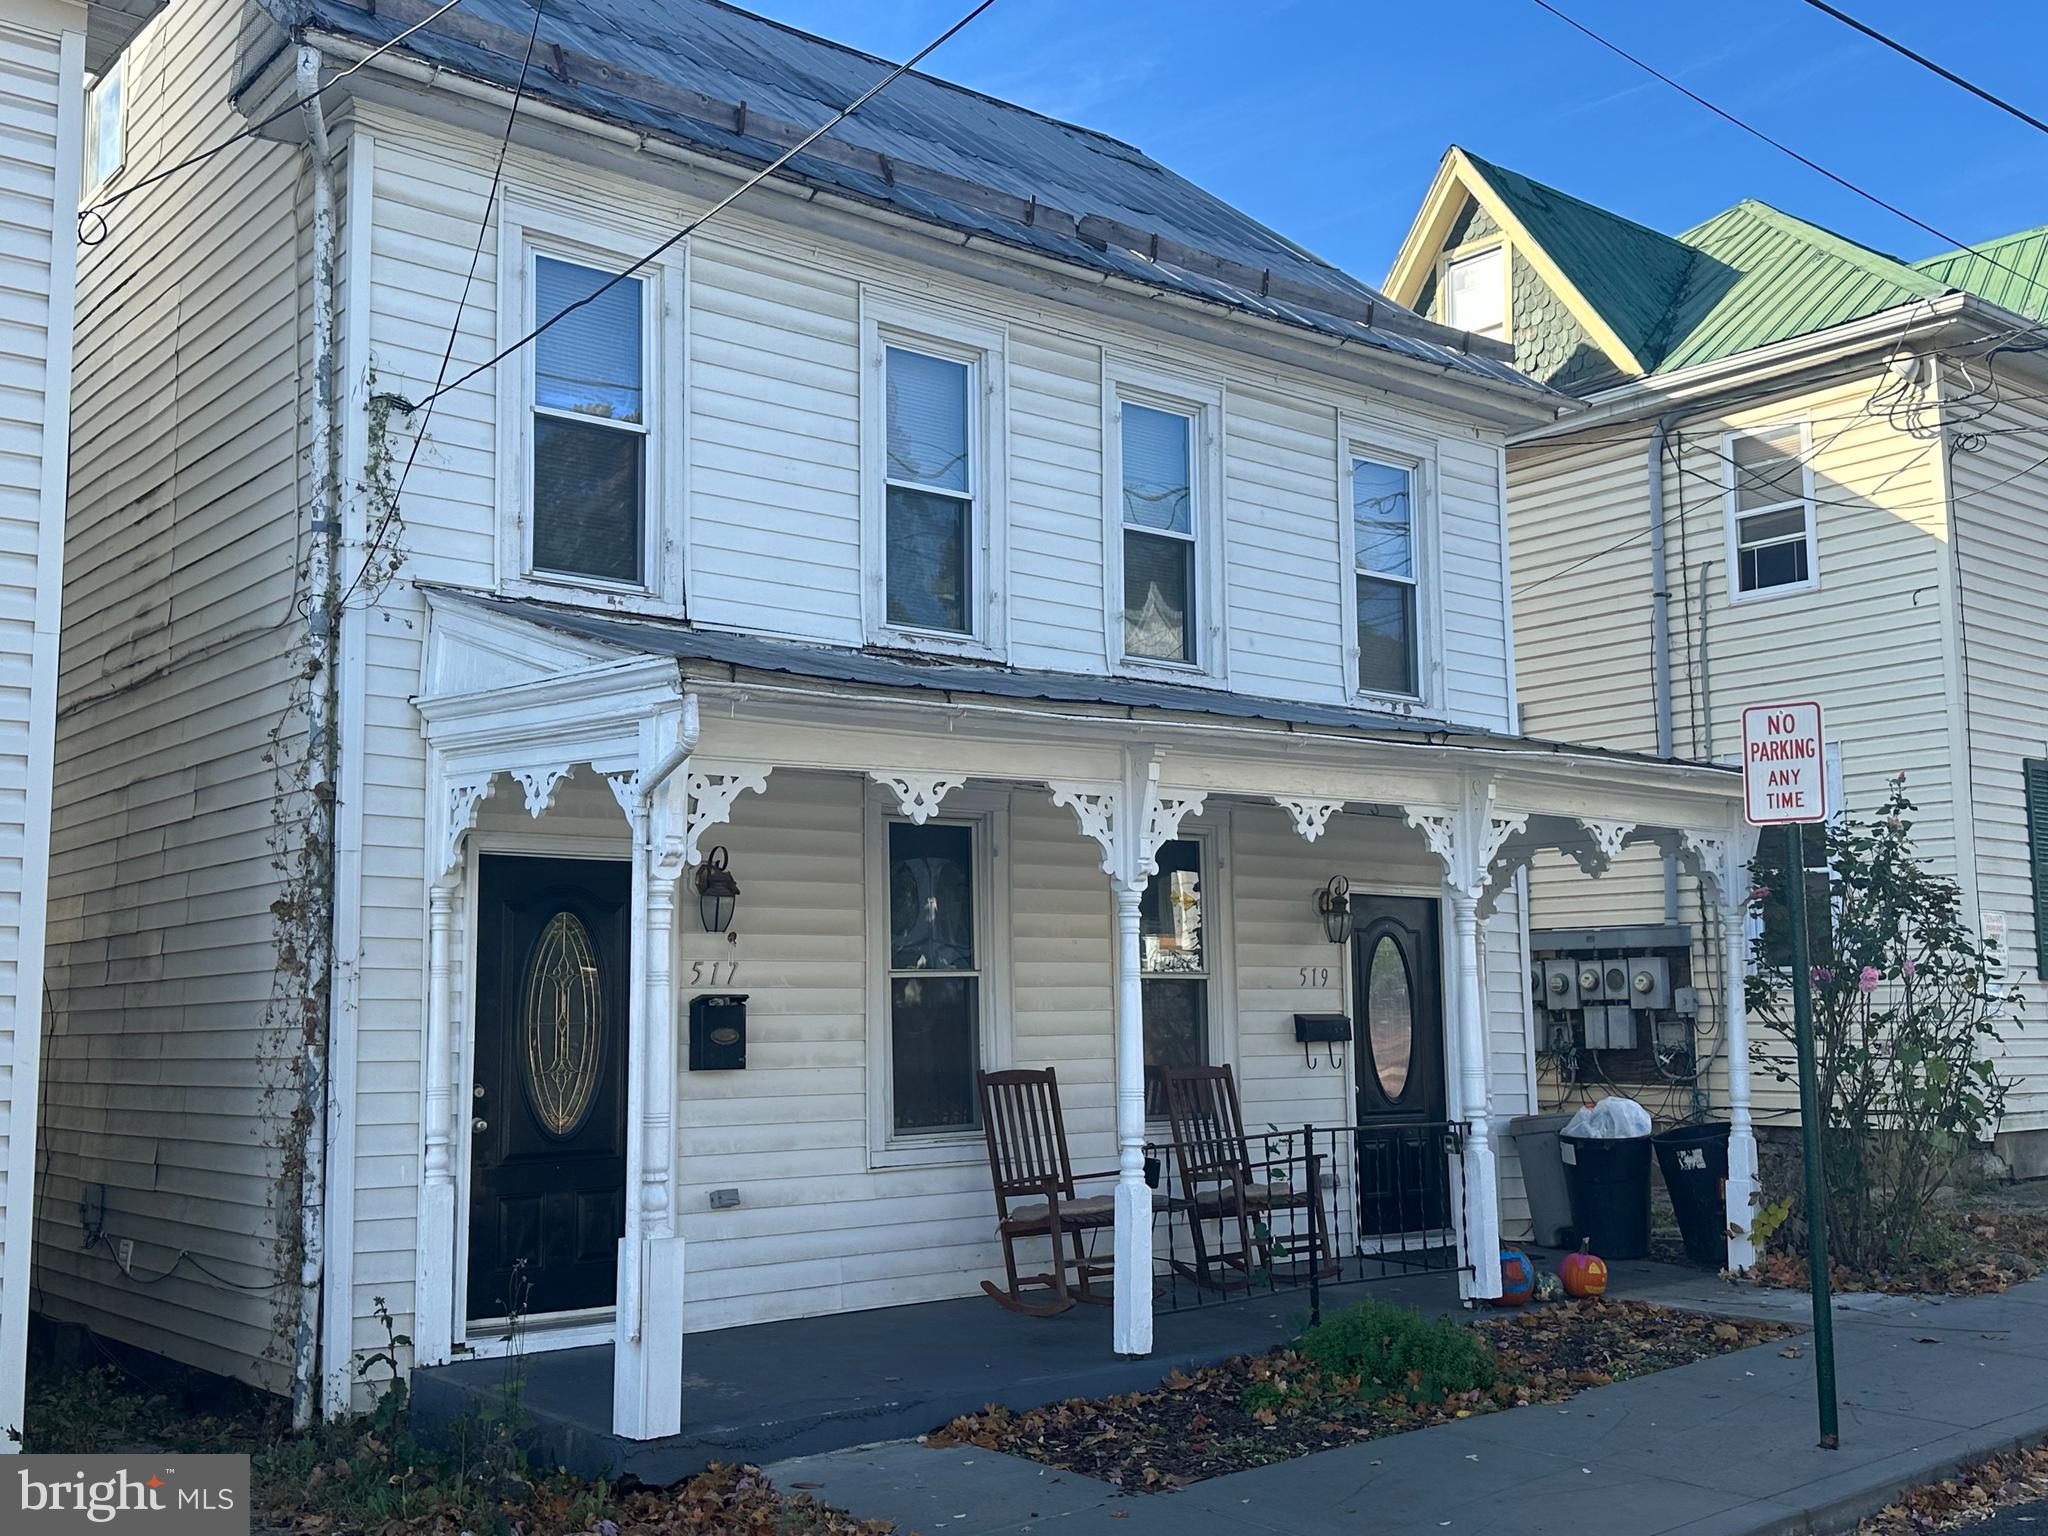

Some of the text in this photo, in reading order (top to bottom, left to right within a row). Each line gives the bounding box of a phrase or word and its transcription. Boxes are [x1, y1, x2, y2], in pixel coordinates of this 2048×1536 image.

[1768, 714, 1795, 735] NO
[1751, 738, 1815, 762] PARKING
[1768, 768, 1800, 787] ANY
[1766, 791, 1805, 809] TIME
[690, 962, 739, 985] 517
[1300, 967, 1328, 987] 519
